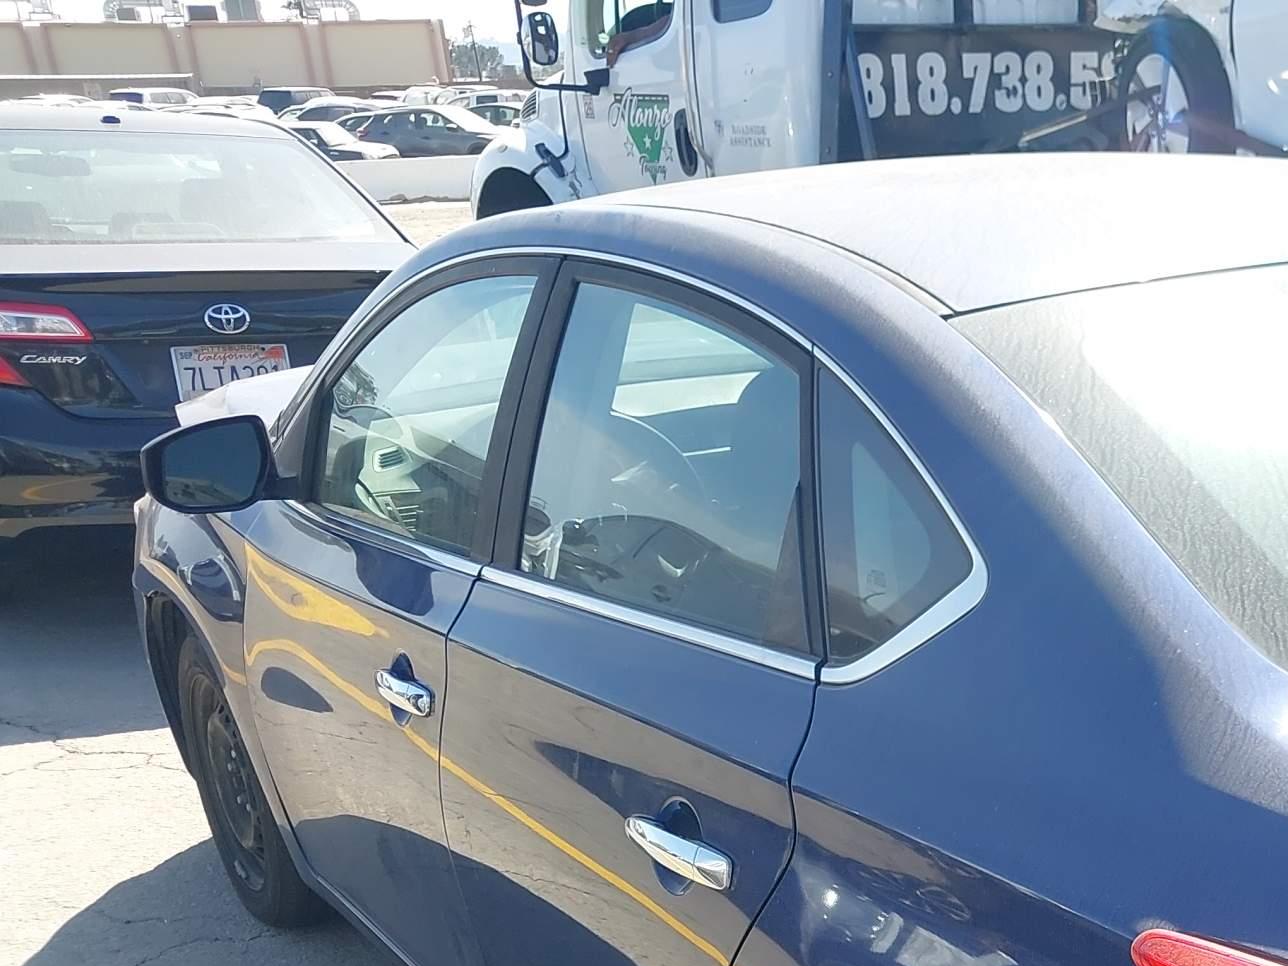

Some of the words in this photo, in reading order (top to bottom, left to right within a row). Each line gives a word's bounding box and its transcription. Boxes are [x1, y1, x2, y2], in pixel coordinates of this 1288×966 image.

[608, 87, 672, 141] Alonzo
[20, 354, 87, 365] CAMRY
[198, 351, 258, 365] California
